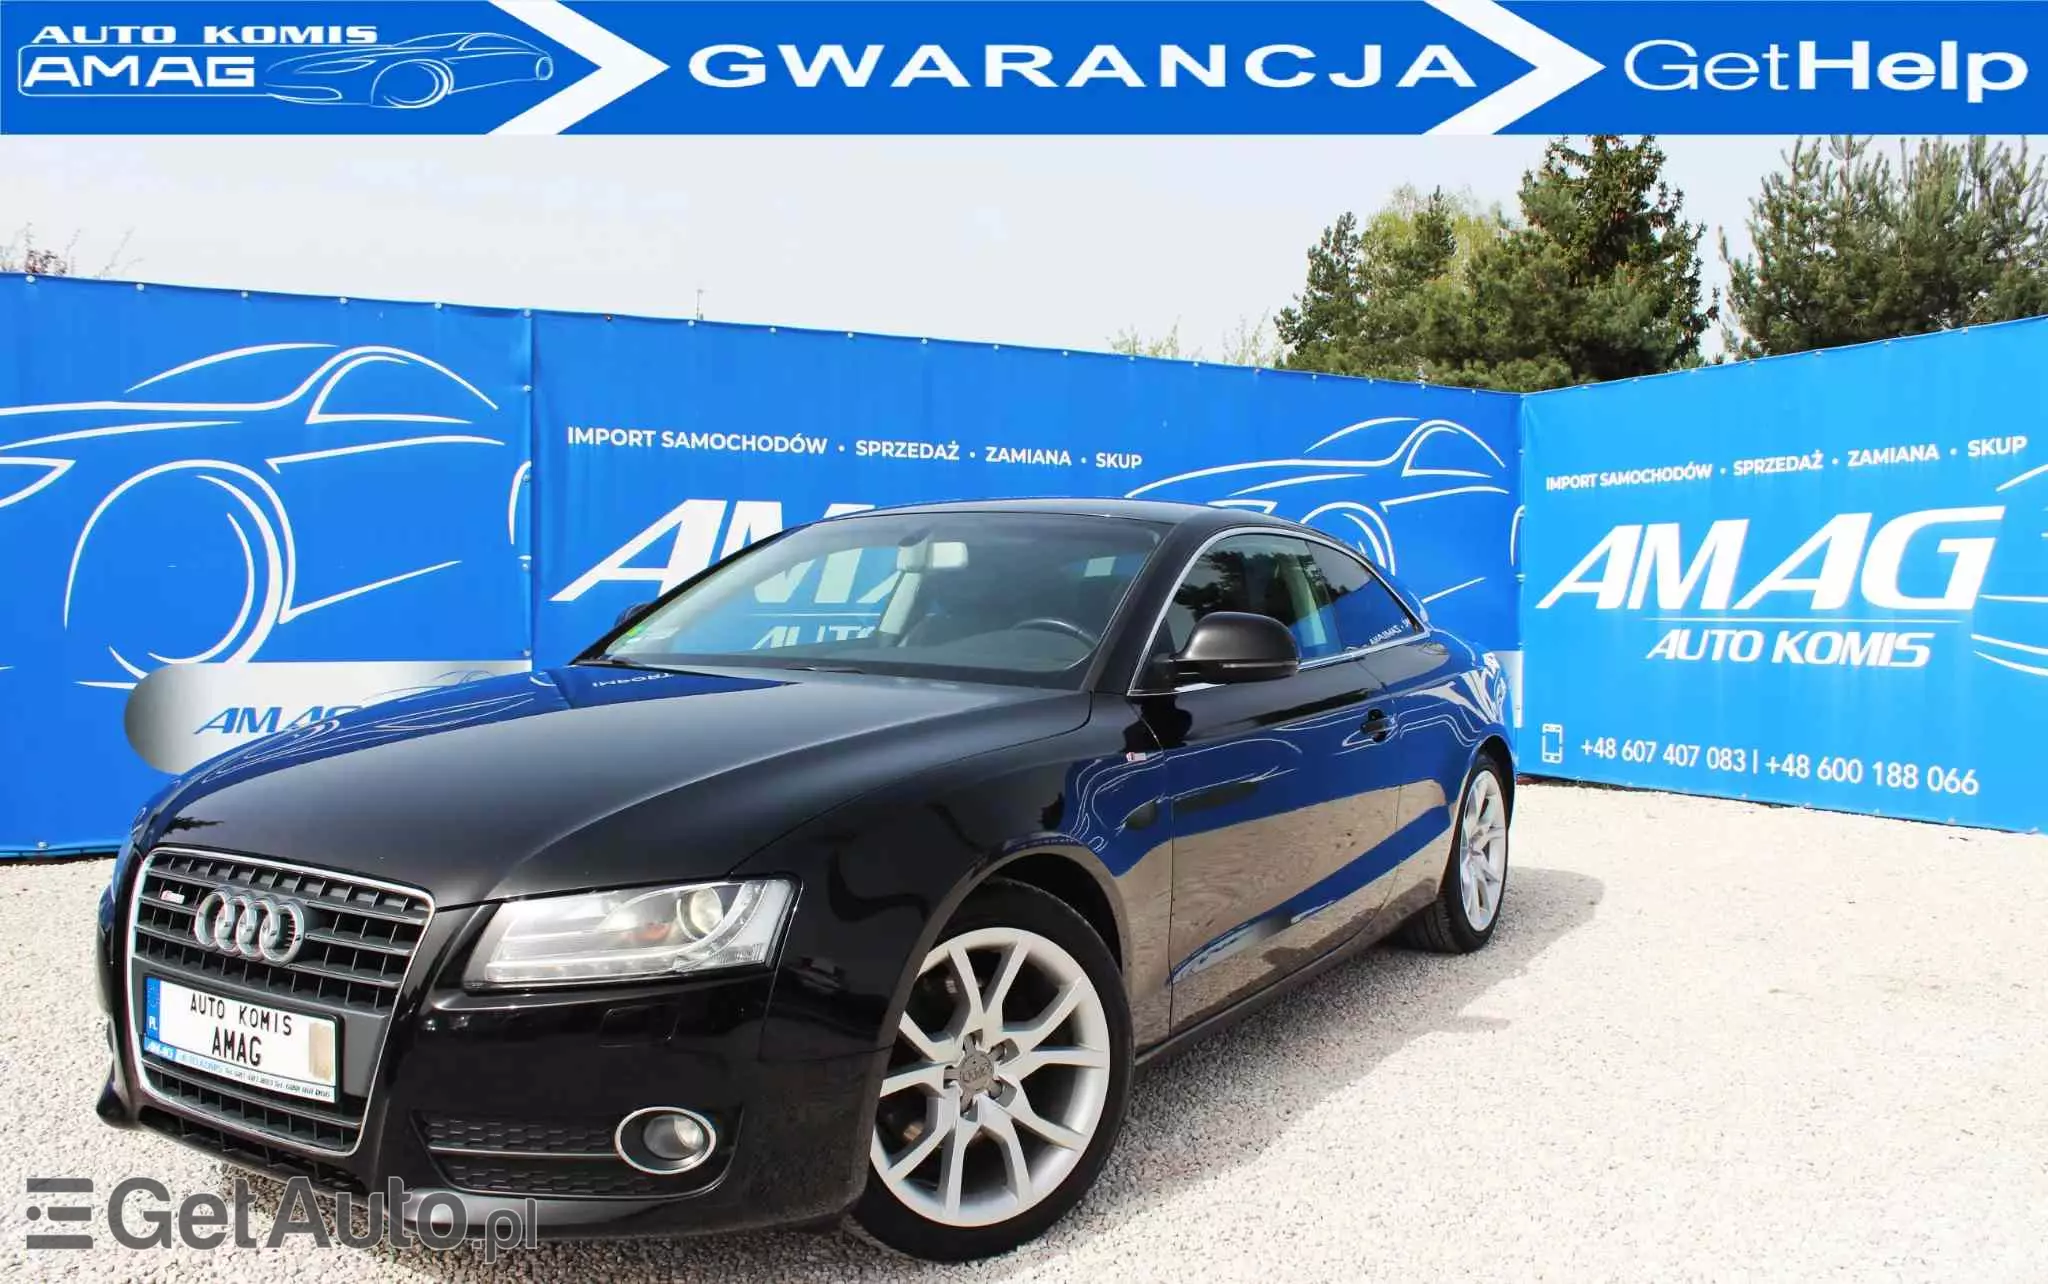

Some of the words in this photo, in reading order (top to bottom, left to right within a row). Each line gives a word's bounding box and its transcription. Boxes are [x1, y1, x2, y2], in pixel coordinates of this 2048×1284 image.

[567, 426, 656, 447] IMPORT
[661, 431, 827, 454] SAMOCHODÓW
[856, 440, 960, 461] SPRZEDAŻ
[985, 446, 1071, 466] ZAMIANA
[1095, 452, 1142, 469] SKUP
[1546, 473, 1597, 490] IMPORT
[1600, 463, 1712, 487] SAMOCHODÓW
[1733, 450, 1823, 476] SPRZEDAŻ
[1847, 443, 1940, 467] ZAMIANA
[1967, 436, 2027, 457] SKUP
[1535, 505, 2006, 611] AMAG
[1646, 629, 1764, 662] AUTO
[1772, 631, 1935, 668] KOMIS
[1581, 738, 1616, 759] +48
[1622, 740, 1657, 763] 607
[1663, 743, 1700, 767] 407
[1706, 746, 1746, 772] 083
[1766, 753, 1810, 779] +48
[1816, 757, 1863, 784] 600
[1873, 762, 1919, 789] 188
[1927, 766, 1979, 796] 066
[190, 993, 225, 1019] AUTO
[239, 1005, 293, 1037] KOMIS
[211, 1026, 263, 1067] AMAG
